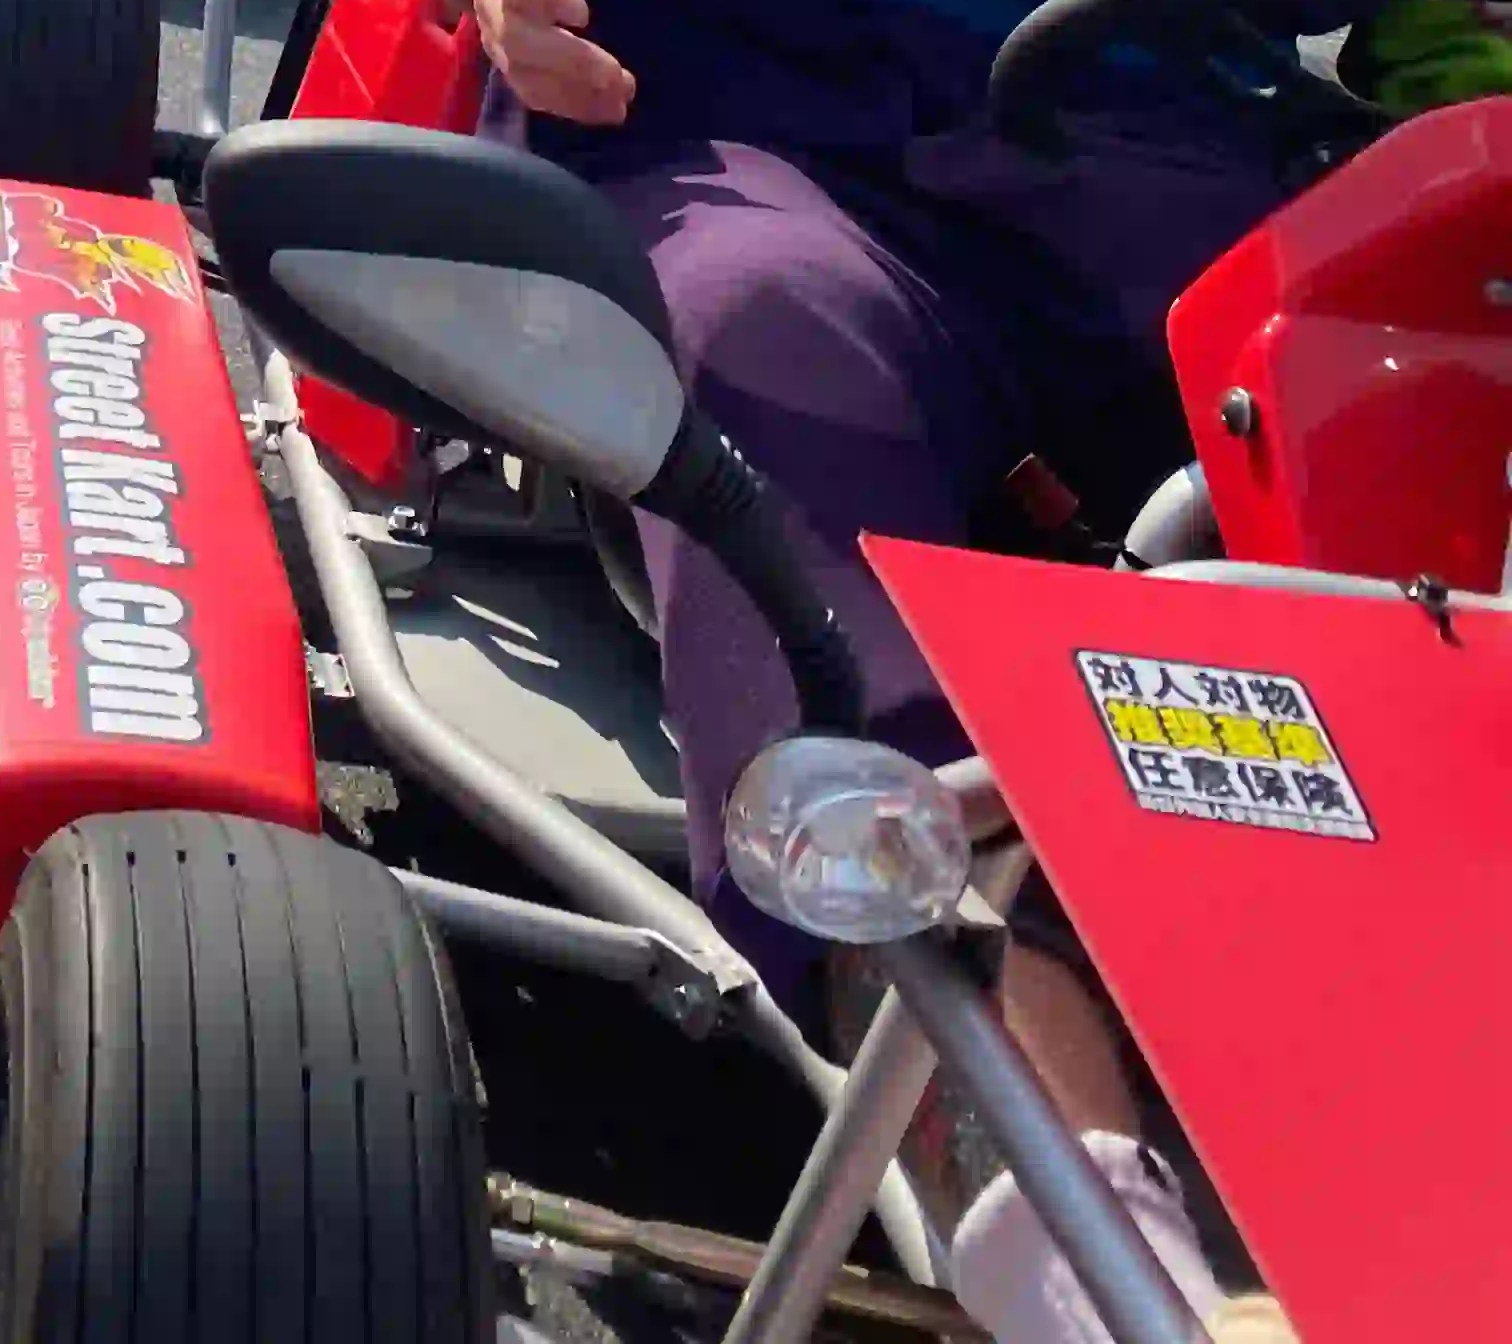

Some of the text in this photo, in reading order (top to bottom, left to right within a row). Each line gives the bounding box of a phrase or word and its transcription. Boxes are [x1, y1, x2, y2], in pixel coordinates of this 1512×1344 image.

[41, 312, 161, 449] Street
[17, 552, 47, 570] by
[1088, 658, 1306, 720] 対人対物
[1128, 747, 1355, 816] 任意保険
